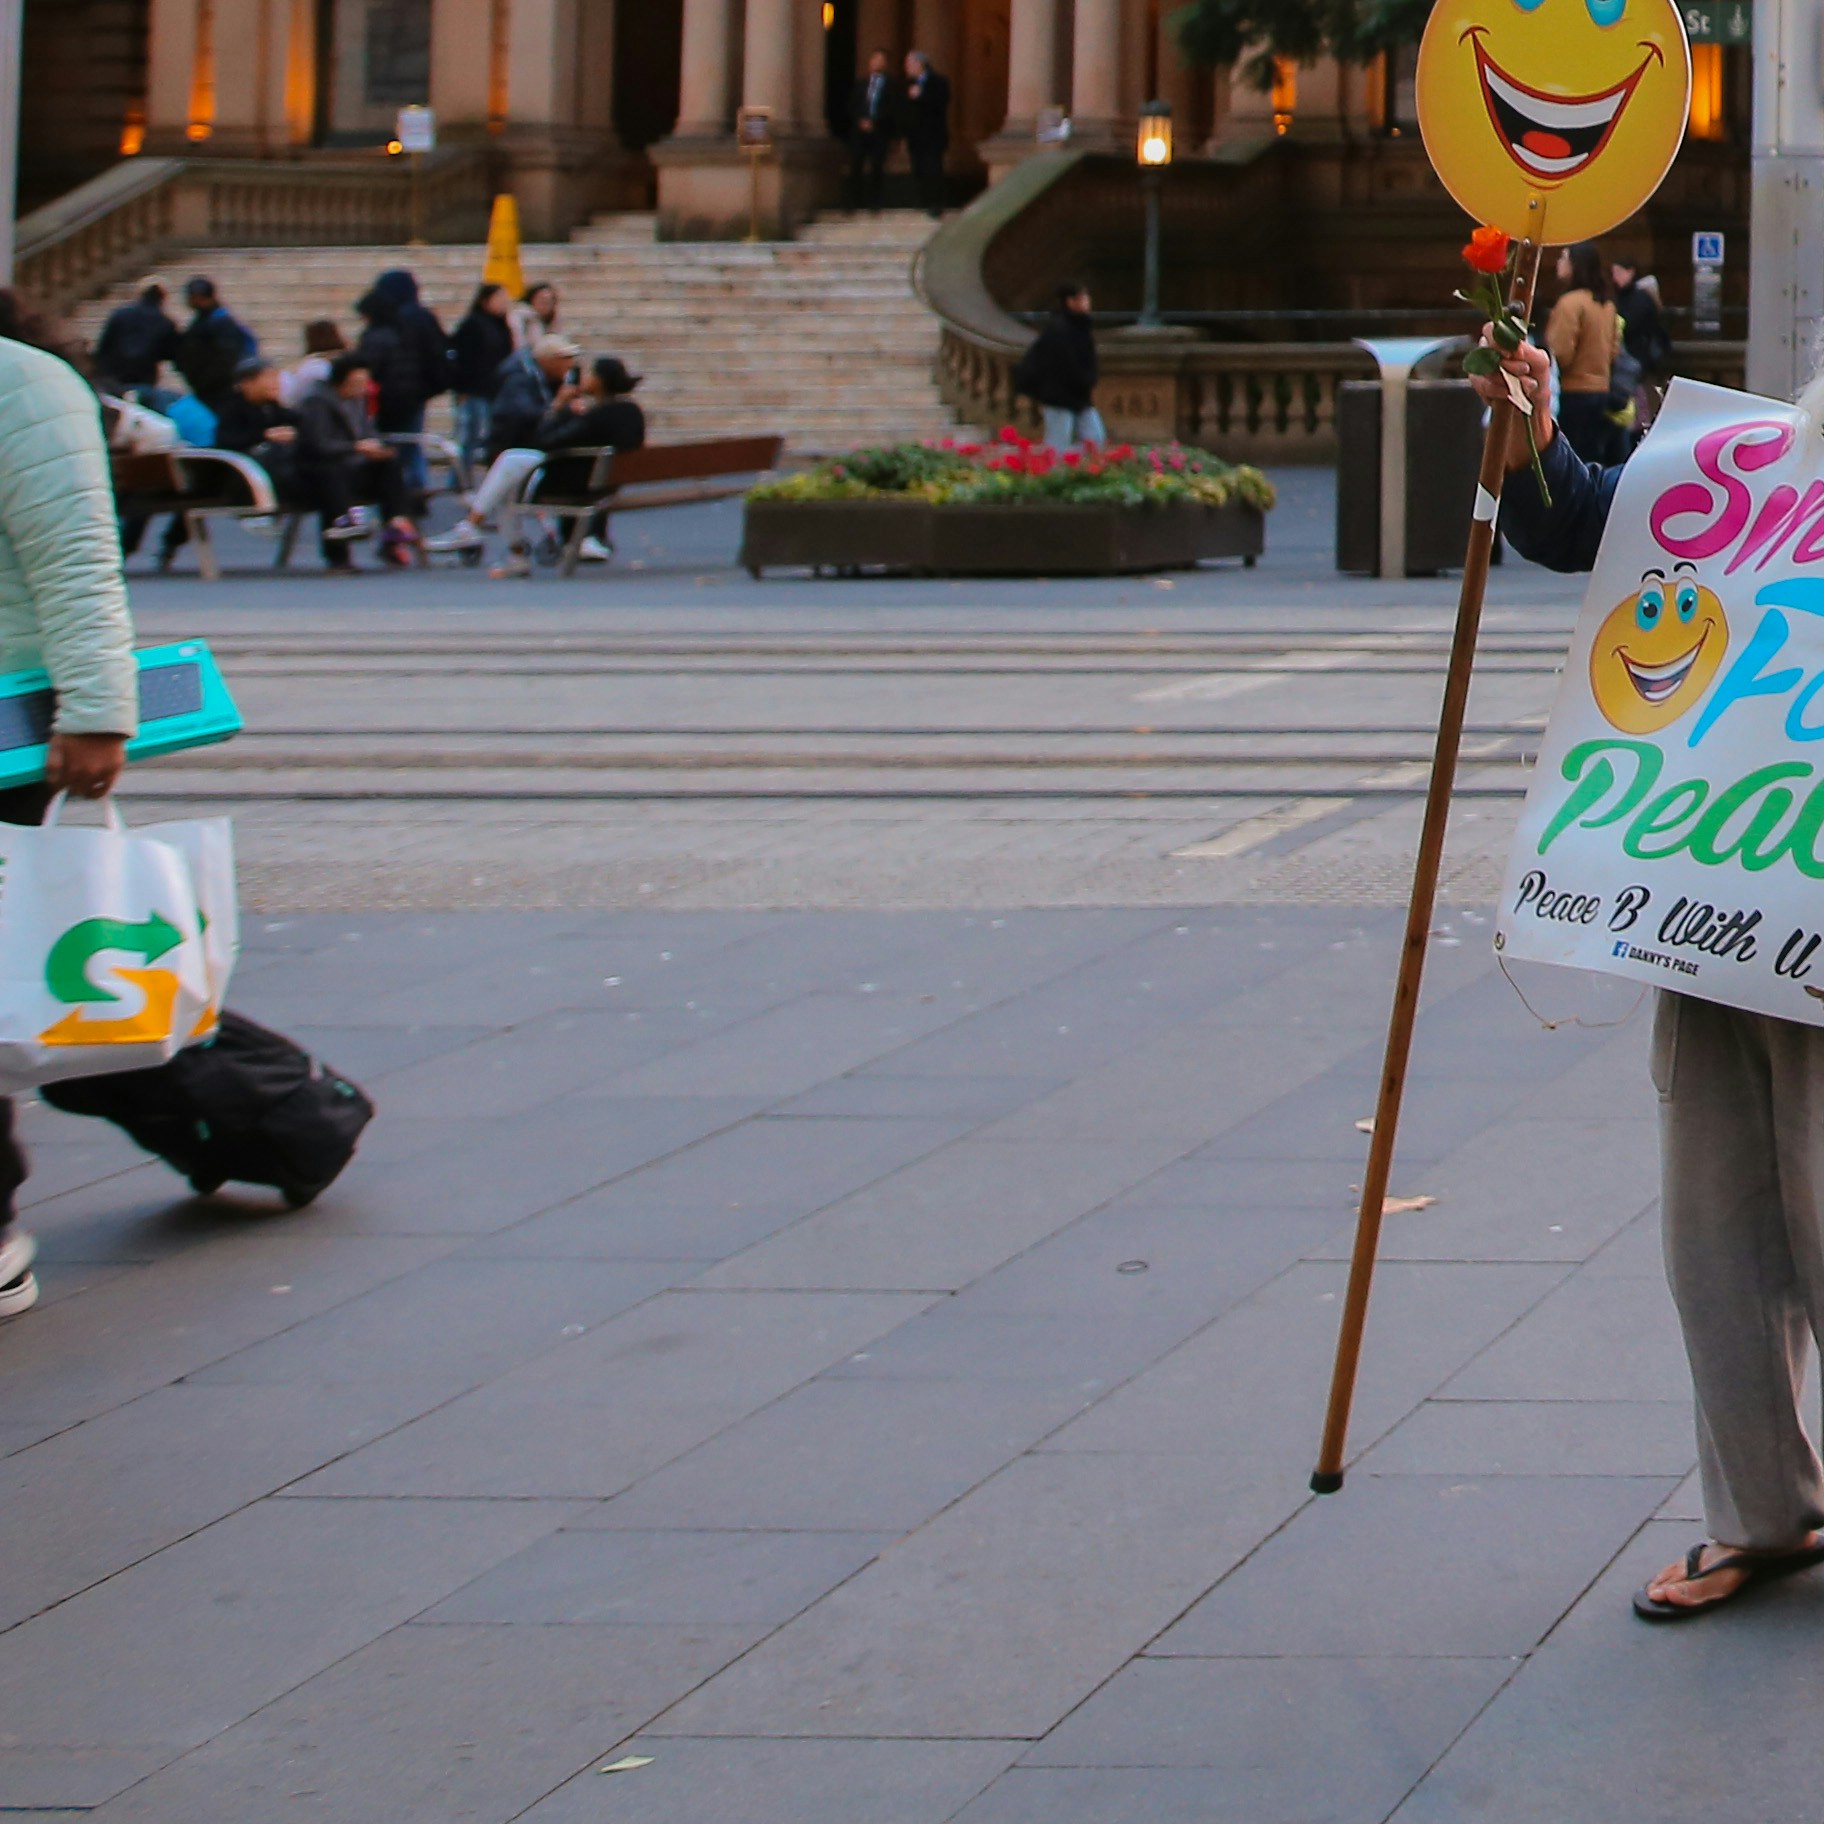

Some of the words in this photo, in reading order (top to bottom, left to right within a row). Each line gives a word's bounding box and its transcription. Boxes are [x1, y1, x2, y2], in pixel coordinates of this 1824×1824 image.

[1686, 9, 1711, 35] St
[1514, 870, 1600, 924] Peace
[1608, 886, 1651, 932] B
[1657, 897, 1763, 963] With
[1774, 929, 1823, 978] U
[1629, 946, 1672, 968] DANNY'S
[1672, 958, 1700, 976] PAGE
